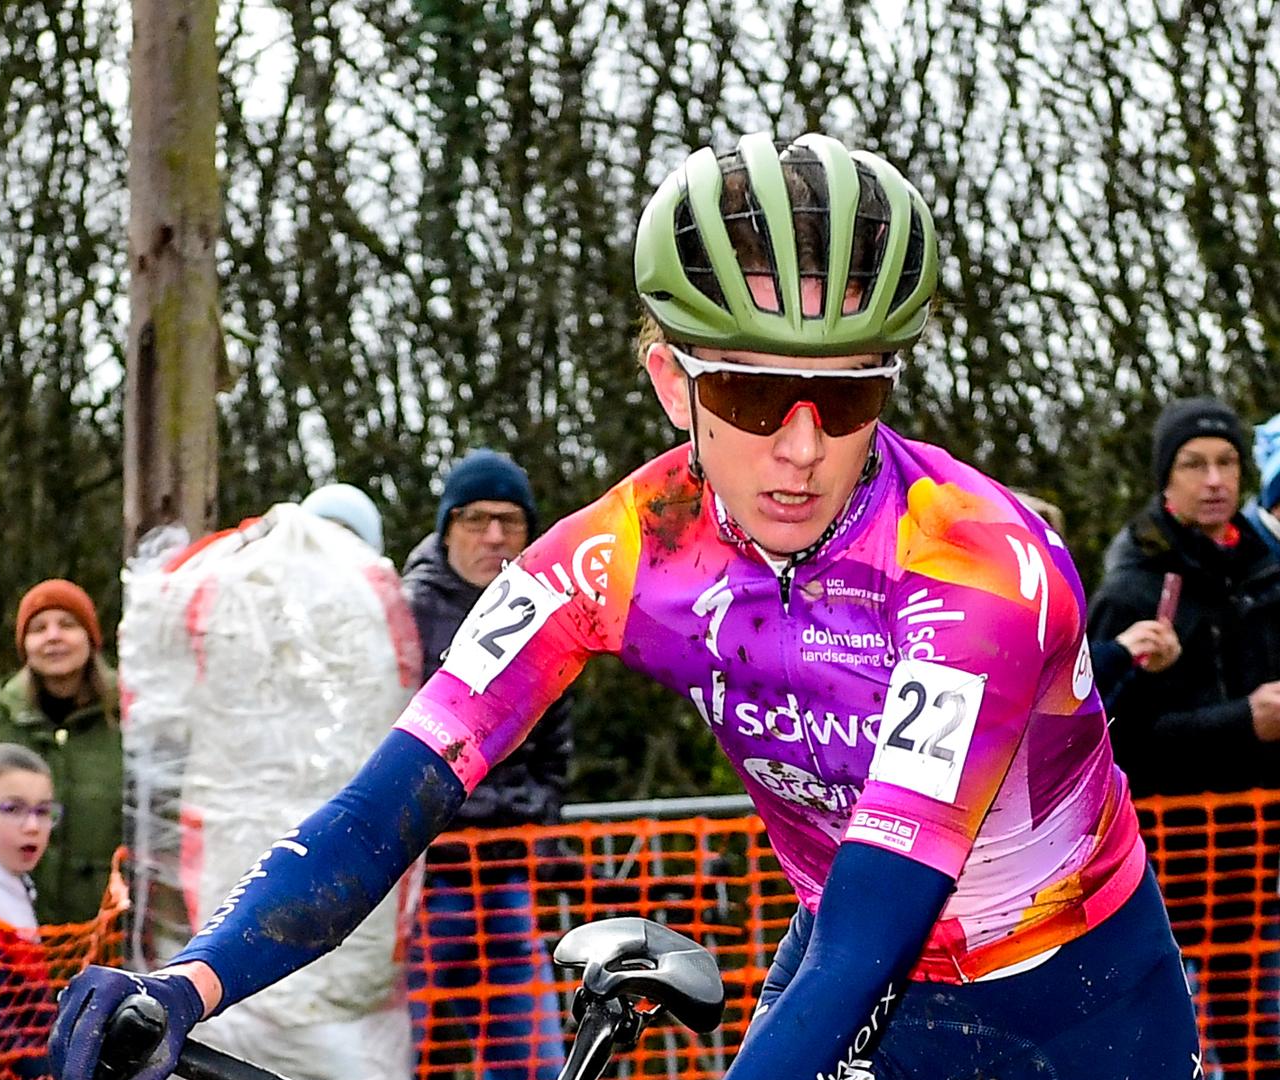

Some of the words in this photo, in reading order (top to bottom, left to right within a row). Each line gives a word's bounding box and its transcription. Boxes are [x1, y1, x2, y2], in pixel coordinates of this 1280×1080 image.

[802, 623, 886, 649] dolmans
[802, 648, 881, 668] landscaping
[886, 680, 967, 762] 22
[852, 813, 913, 838] Boels
